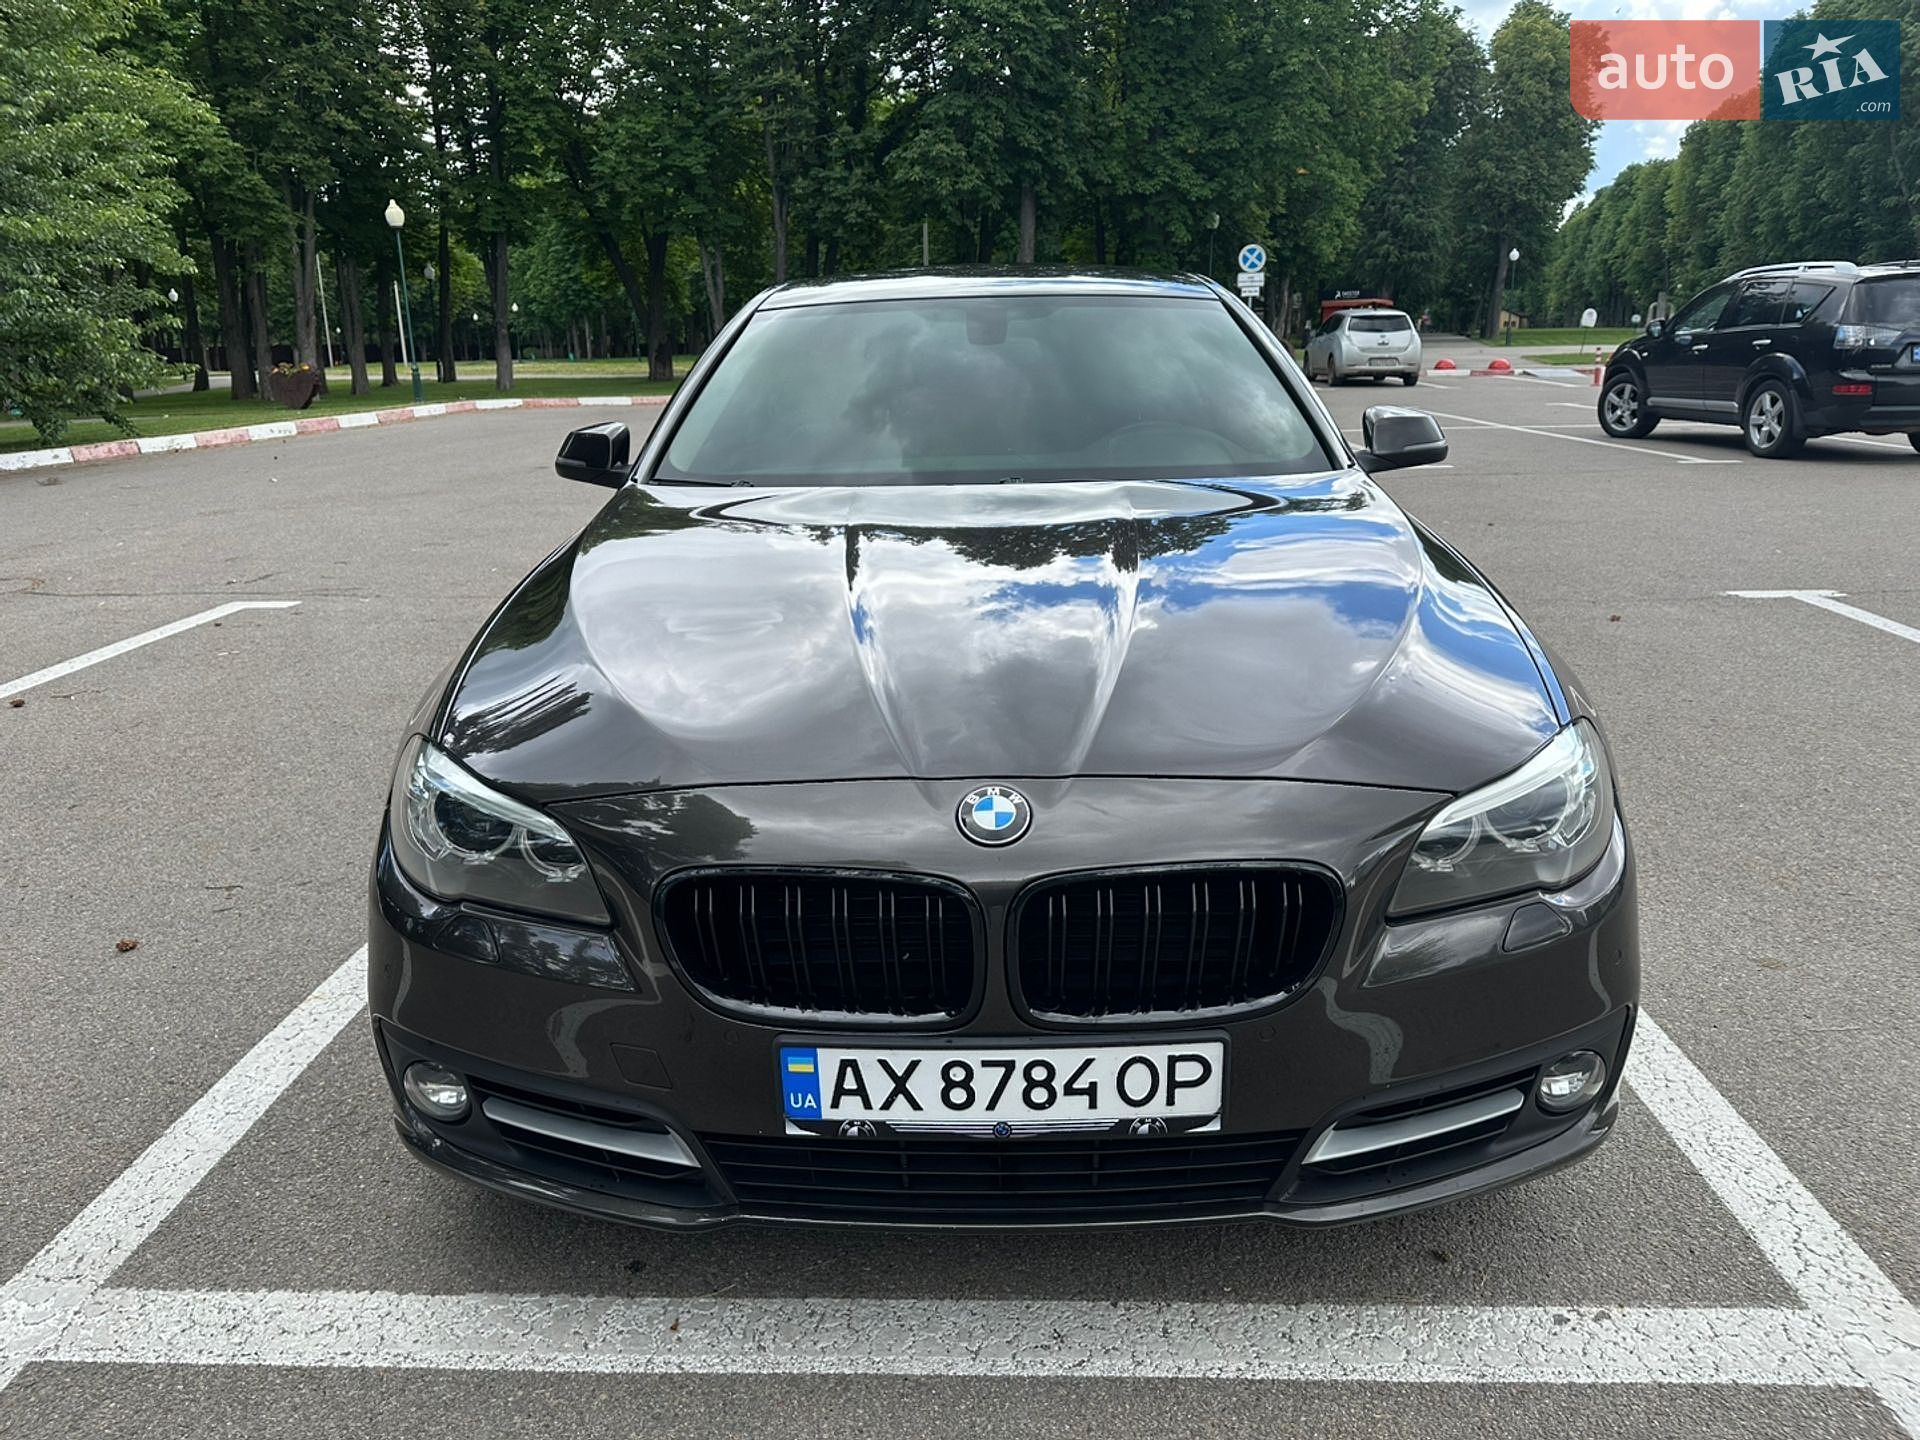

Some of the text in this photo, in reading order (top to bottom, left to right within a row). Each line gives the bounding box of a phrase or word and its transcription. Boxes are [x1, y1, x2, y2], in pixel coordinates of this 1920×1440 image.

[966, 786, 1024, 804] BMW
[829, 1054, 1213, 1111] AX 8784 OP
[789, 1093, 818, 1109] UA
